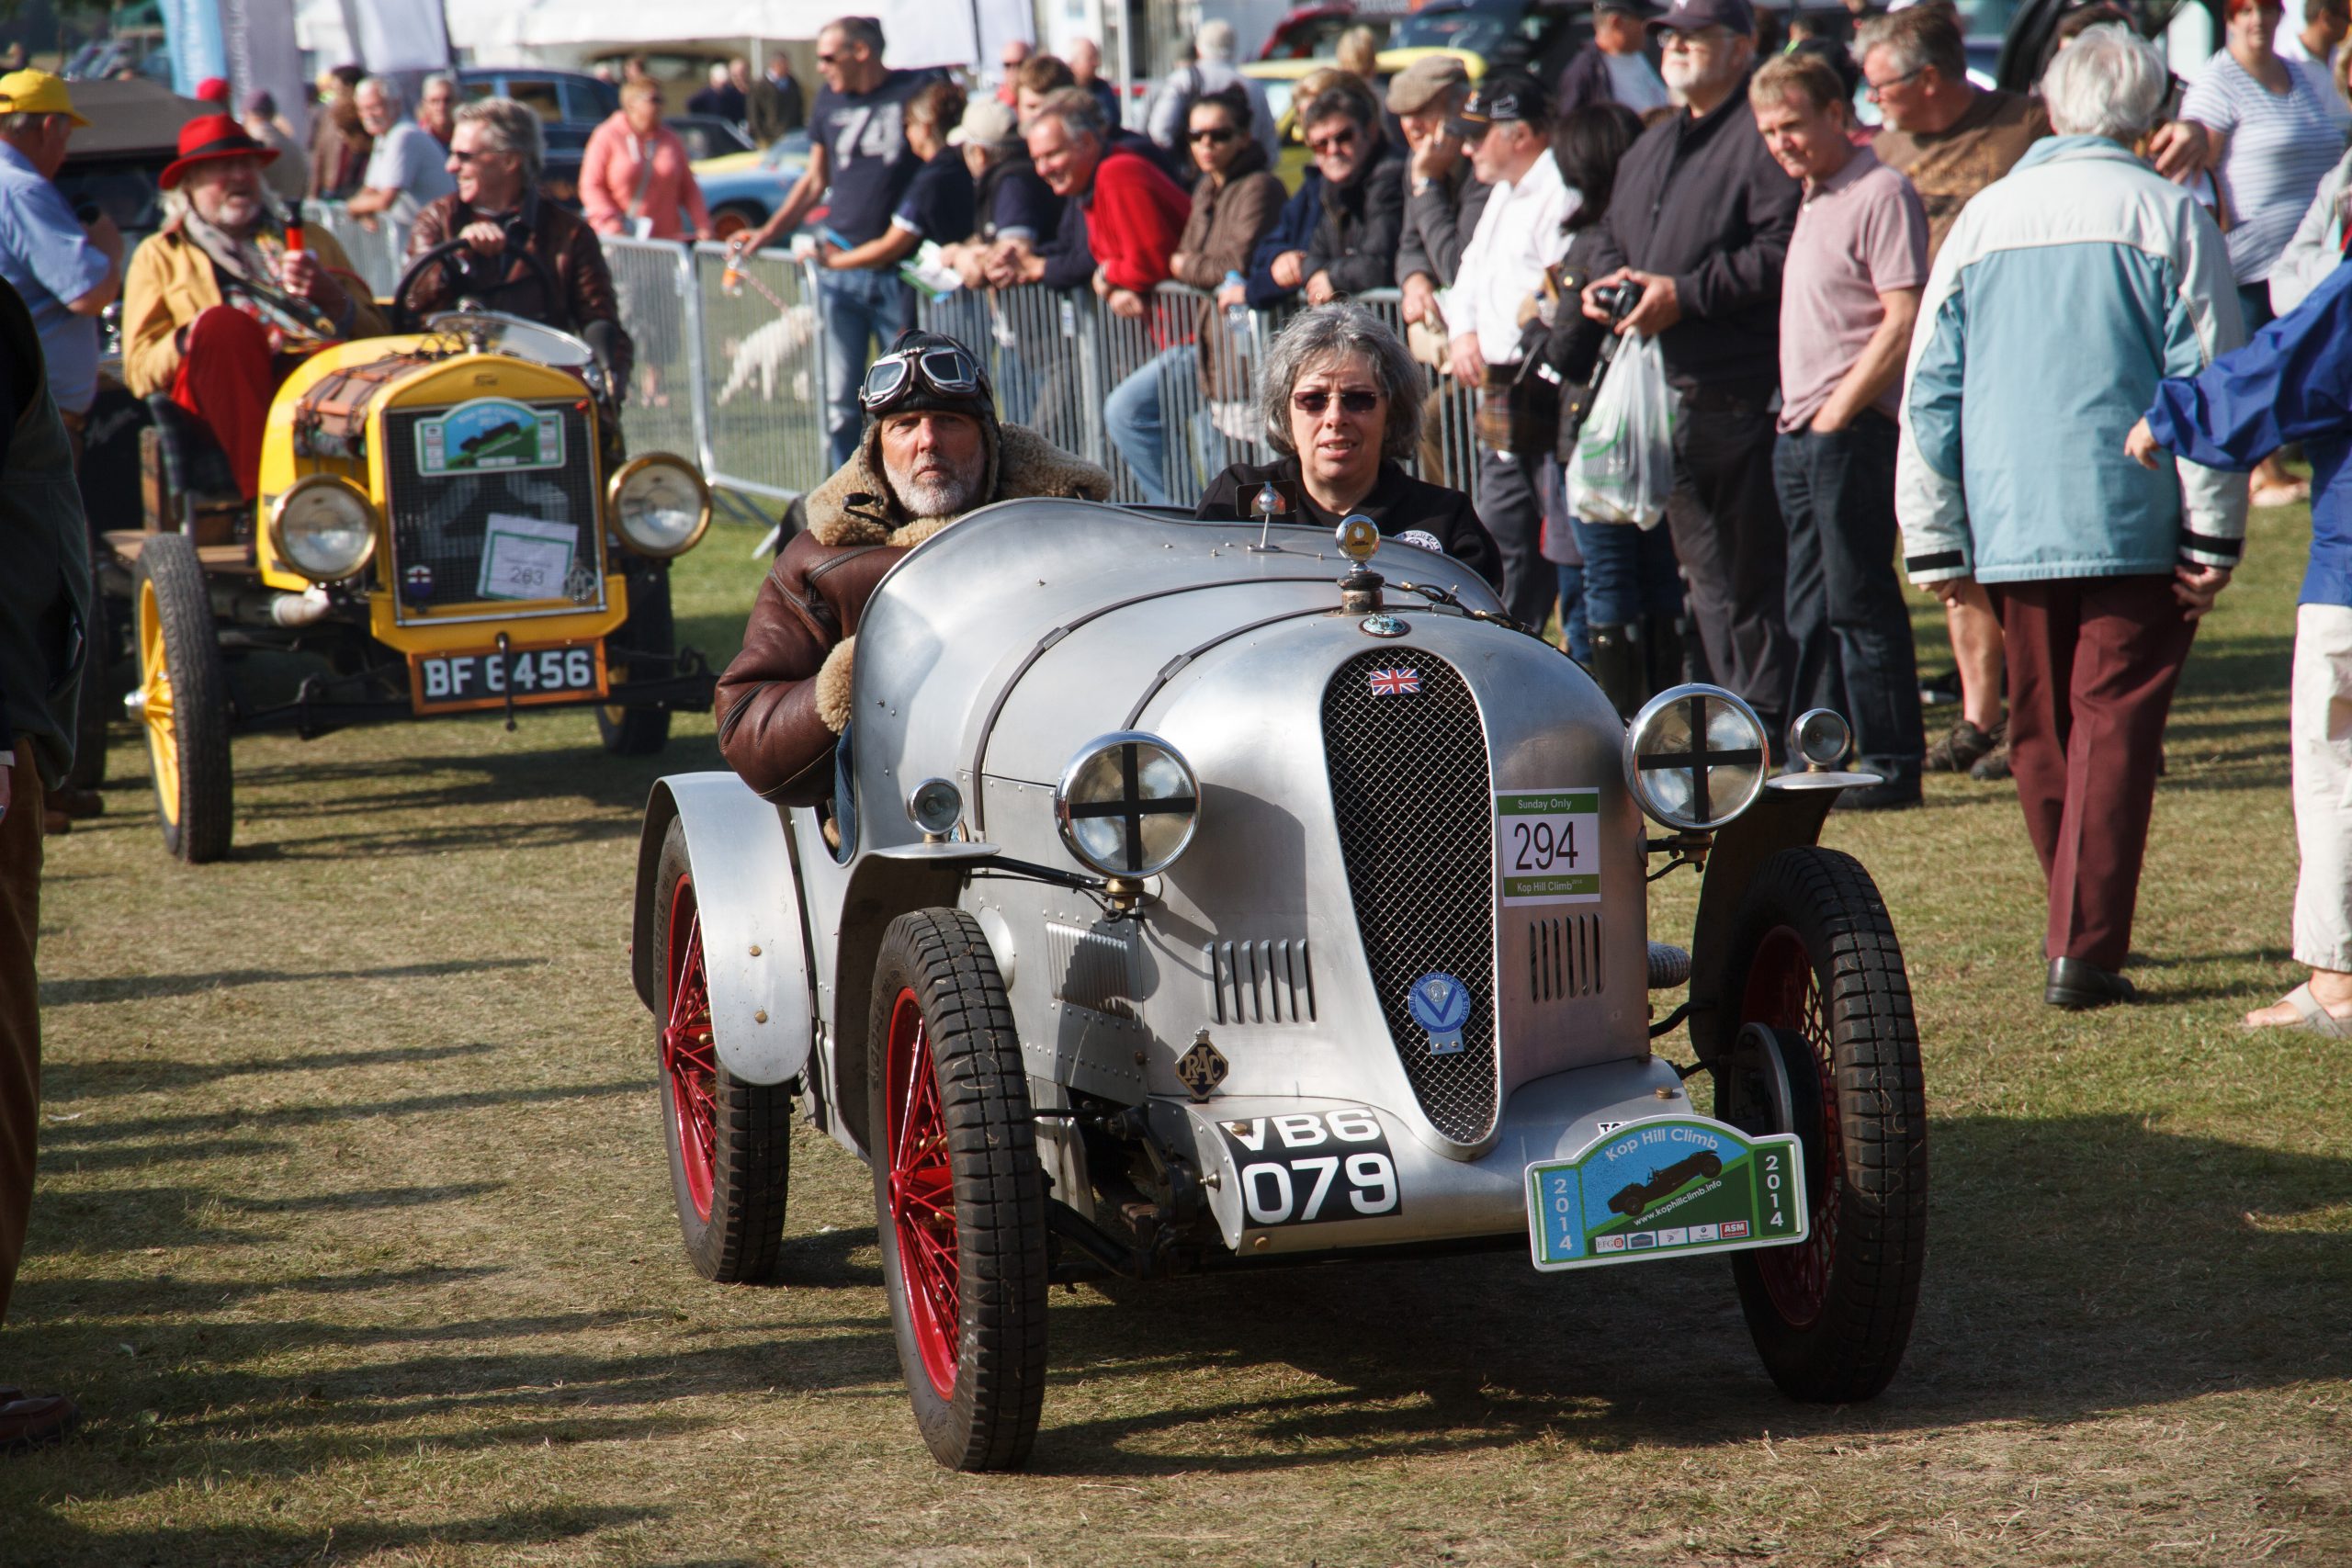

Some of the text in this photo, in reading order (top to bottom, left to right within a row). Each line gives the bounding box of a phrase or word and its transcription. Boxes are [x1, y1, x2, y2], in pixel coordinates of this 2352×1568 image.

[829, 102, 902, 171] 74
[424, 649, 591, 697] BF 6456
[1518, 798, 1572, 810] Sunday Only
[1514, 821, 1578, 870] 294
[1517, 883, 1532, 894] Kop
[1533, 882, 1546, 891] Hill
[1185, 1046, 1222, 1085] RAC
[1219, 1109, 1380, 1151] VB6
[1605, 1128, 1718, 1161] Kop Hill Climb
[1242, 1153, 1397, 1224] 079
[1634, 1180, 1723, 1225] www.kophillclimb.info
[1766, 1155, 1783, 1226] 2014
[1555, 1179, 1572, 1250] 2014
[1724, 1224, 1745, 1233] ASM
